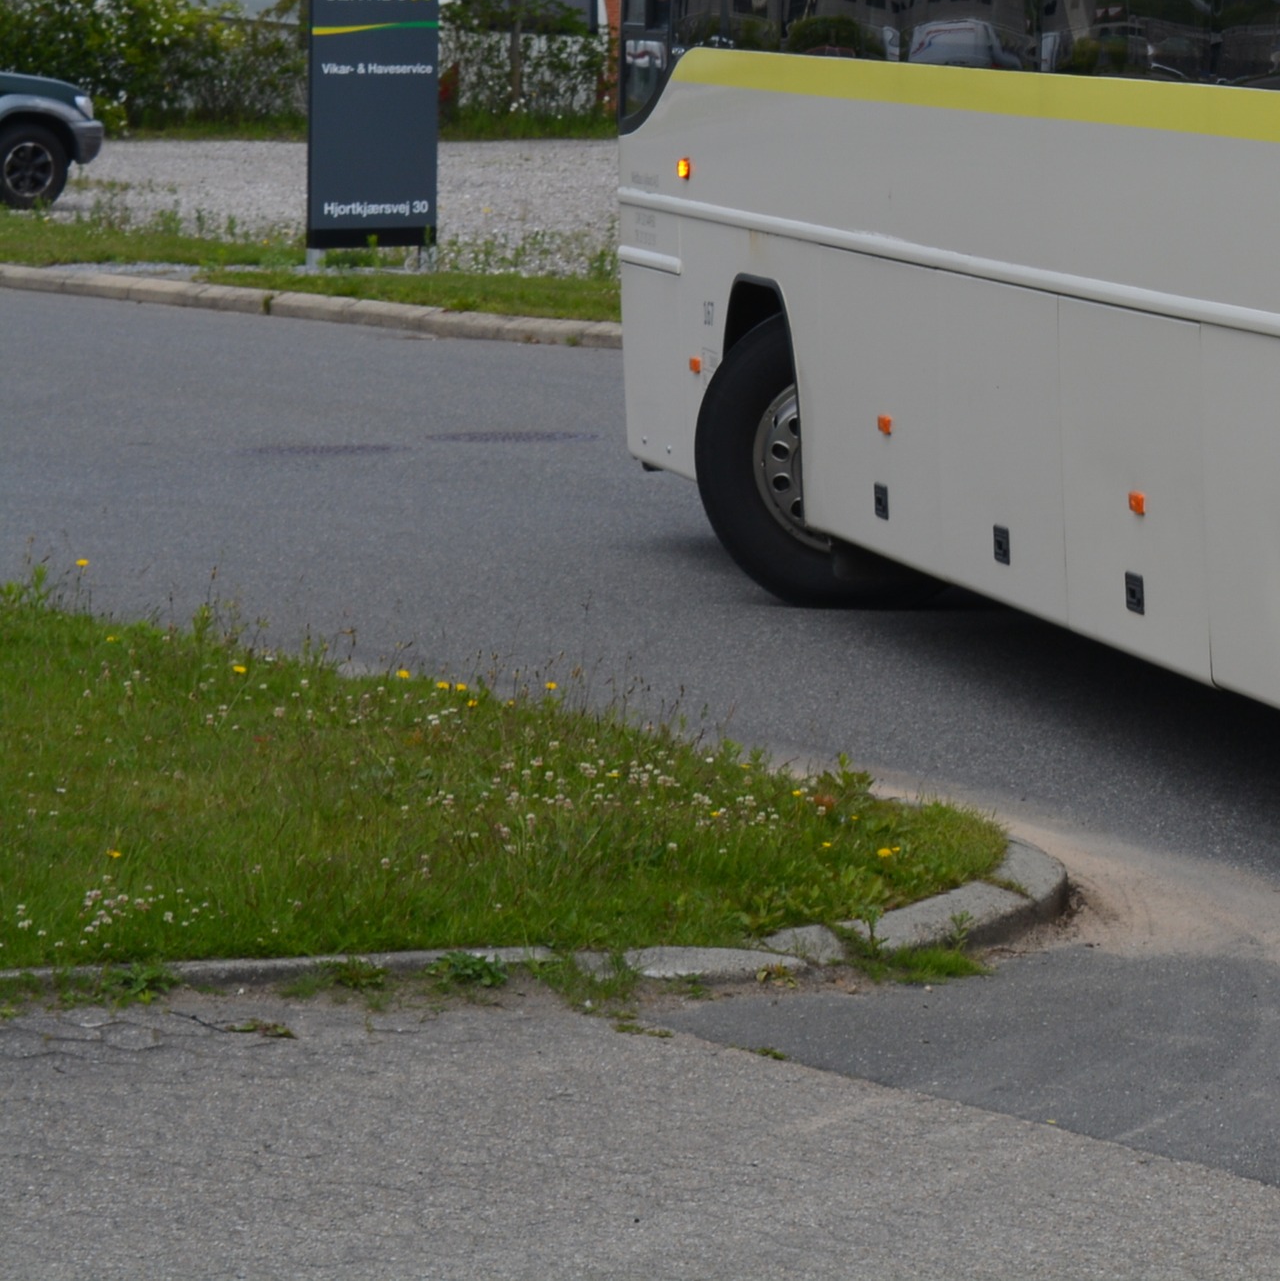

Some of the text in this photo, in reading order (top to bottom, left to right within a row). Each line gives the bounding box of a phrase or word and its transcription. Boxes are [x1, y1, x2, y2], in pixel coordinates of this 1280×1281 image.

[322, 63, 434, 75] Vikar- & Haveservice
[323, 200, 429, 218] Hjortkjærsvej 30
